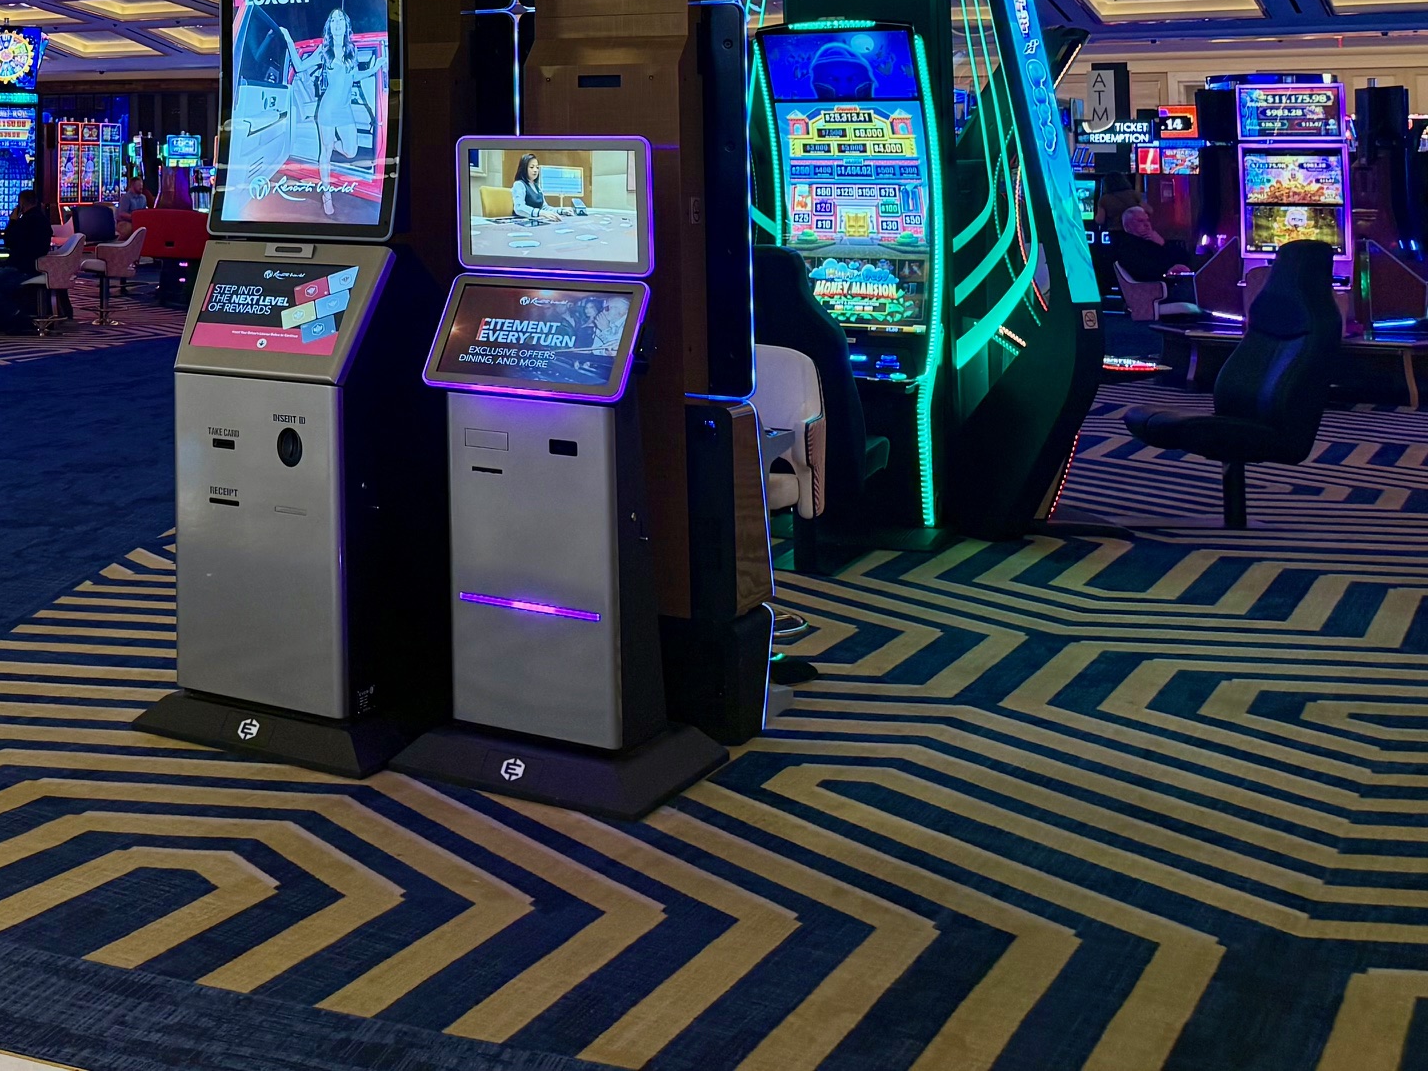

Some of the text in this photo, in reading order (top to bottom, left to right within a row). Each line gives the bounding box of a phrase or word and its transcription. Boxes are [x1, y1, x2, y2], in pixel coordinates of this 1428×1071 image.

[1092, 72, 1109, 122] ATM
[1268, 94, 1327, 103] $11,175.98
[1115, 122, 1149, 132] TICKET
[1089, 133, 1149, 143] REDEMPTION
[214, 285, 263, 295] STEP INTO
[813, 280, 897, 299] MONEY MANSION
[212, 294, 289, 306] THE NEXT LEVEL
[208, 303, 271, 315] OF REWARDS
[479, 330, 576, 348] EVERY TURN
[469, 345, 557, 361] EXCLUSIVE OFFERS,
[459, 354, 548, 368] DINING, AND MORE
[273, 413, 306, 425] INSERT ID
[208, 427, 240, 438] TAKE CARD
[209, 486, 238, 497] RECEIPT
